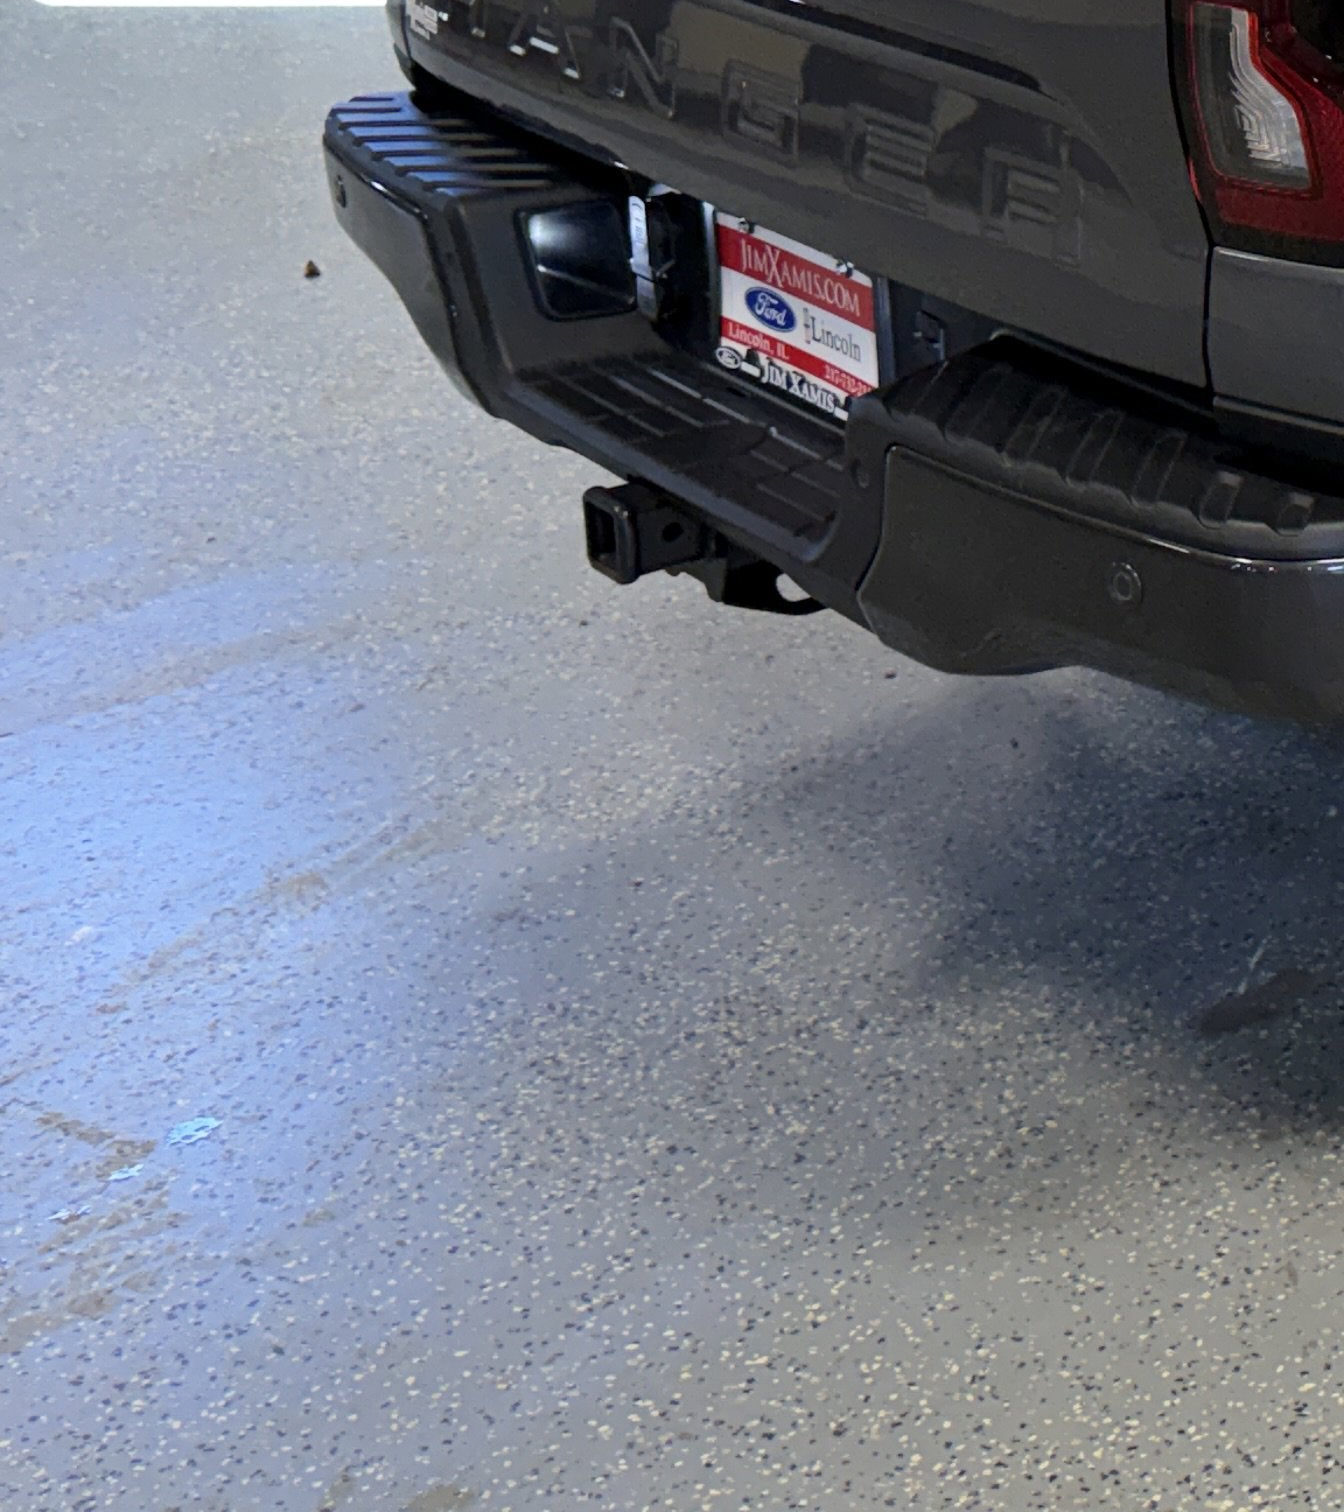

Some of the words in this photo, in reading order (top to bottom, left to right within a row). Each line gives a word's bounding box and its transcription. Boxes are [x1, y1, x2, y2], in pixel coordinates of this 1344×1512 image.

[754, 291, 787, 326] Ford
[728, 321, 774, 355] Lincoln,
[775, 342, 790, 360] IL
[811, 315, 862, 362] Lincoln
[761, 359, 788, 390] JIM
[788, 370, 835, 414] XAMIS
